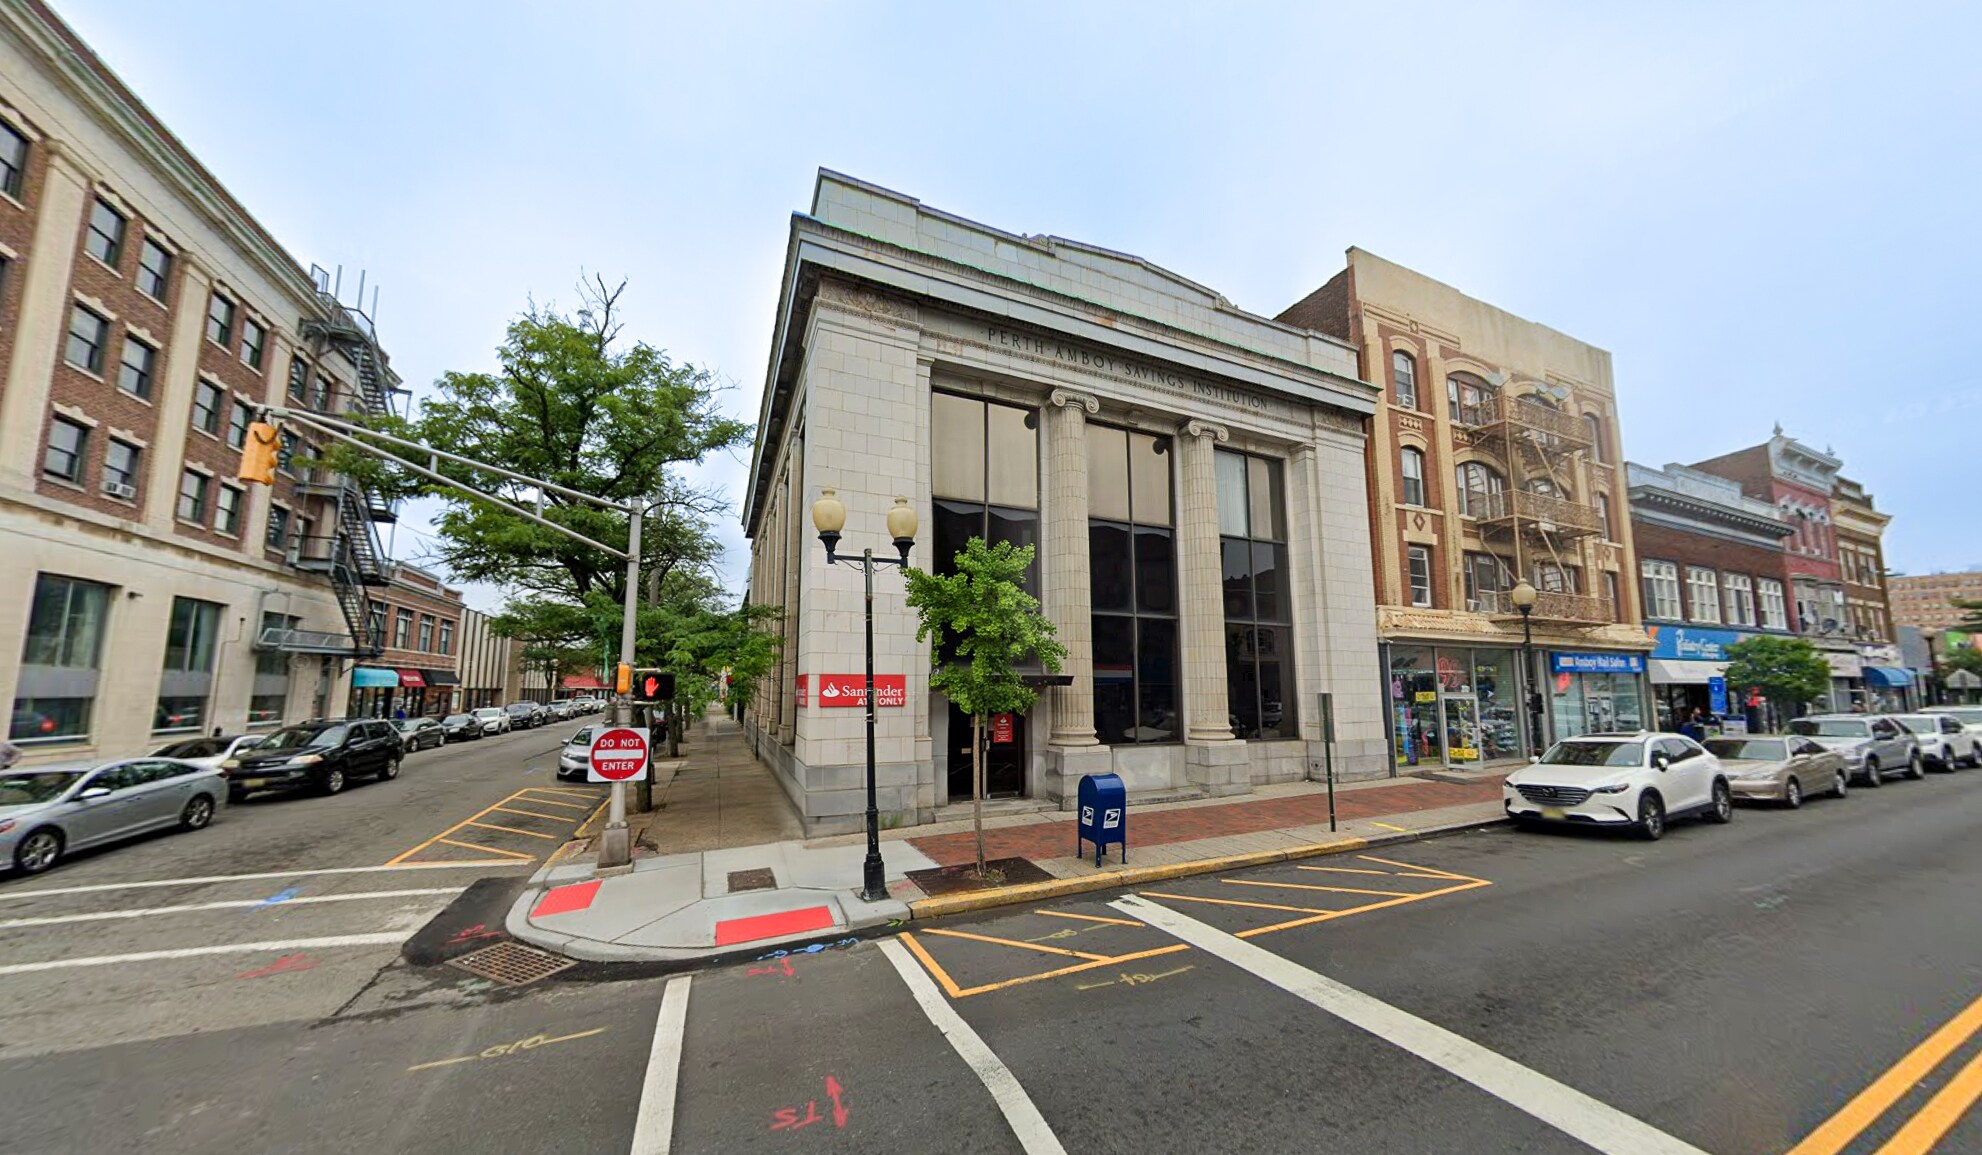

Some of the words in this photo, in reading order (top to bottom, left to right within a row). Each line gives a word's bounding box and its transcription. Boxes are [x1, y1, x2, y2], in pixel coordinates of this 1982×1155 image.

[988, 328, 1044, 353] PERTH
[1055, 347, 1116, 371] AMBOY
[1125, 363, 1184, 388] SAVINGS
[1193, 382, 1267, 408] INSTITUTION
[879, 697, 903, 706] ONLY
[600, 739, 614, 748] DO
[621, 738, 640, 747] NOT
[602, 761, 634, 771] ENTER
